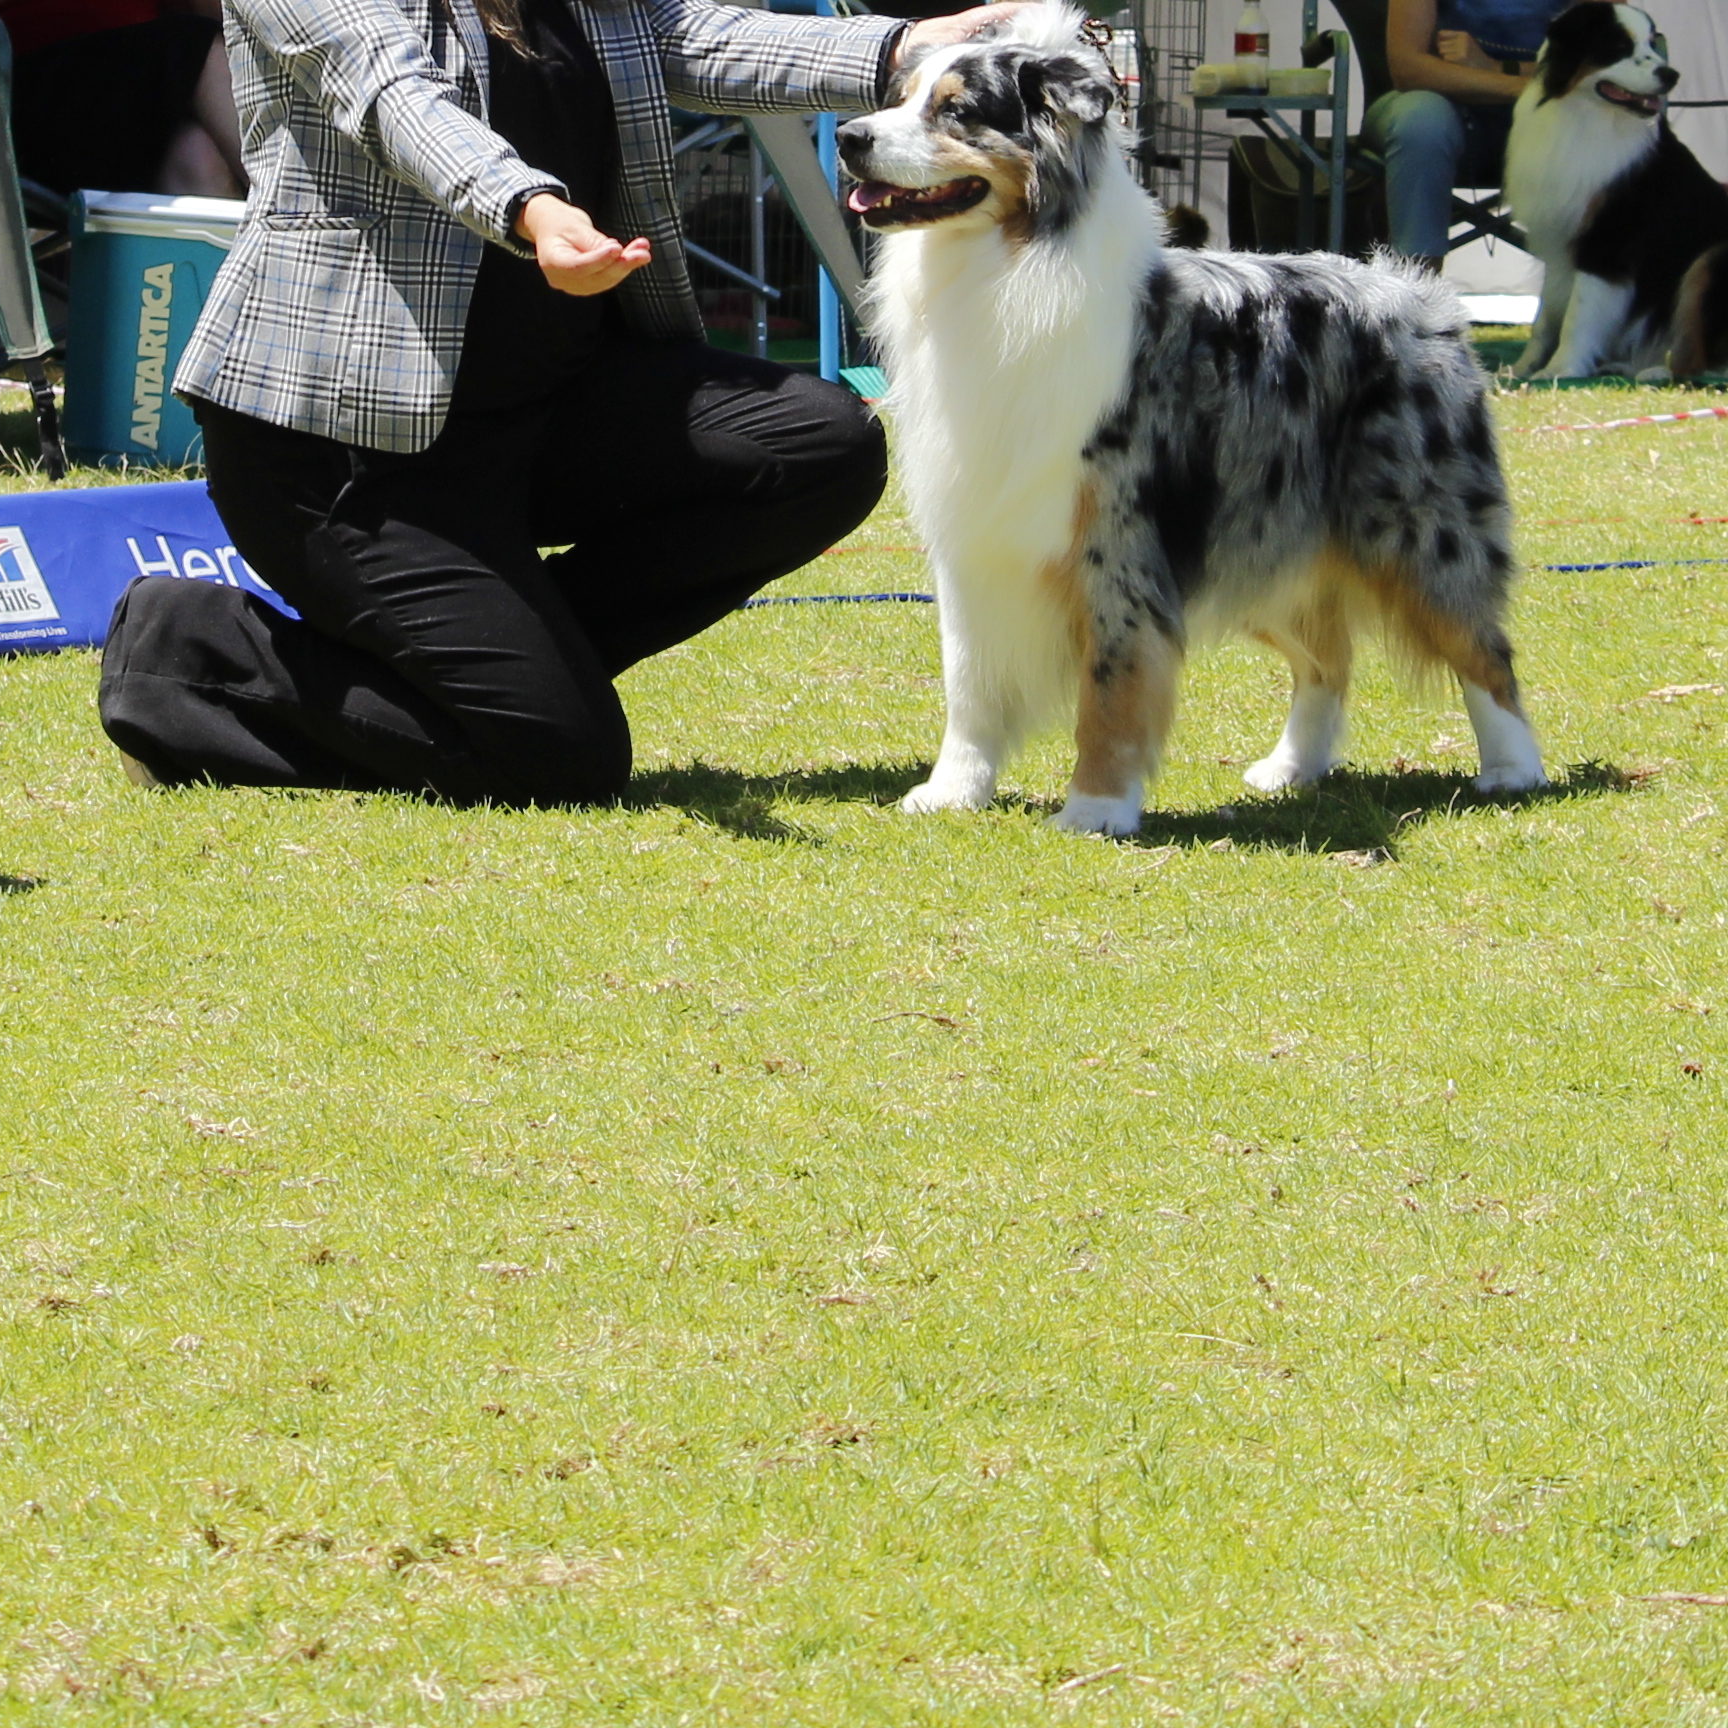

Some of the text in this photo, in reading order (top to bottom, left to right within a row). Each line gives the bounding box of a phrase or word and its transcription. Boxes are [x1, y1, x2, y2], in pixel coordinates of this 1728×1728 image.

[130, 262, 175, 451] ANTARTICA
[125, 534, 273, 592] Her
[45, 626, 69, 637] Lives
